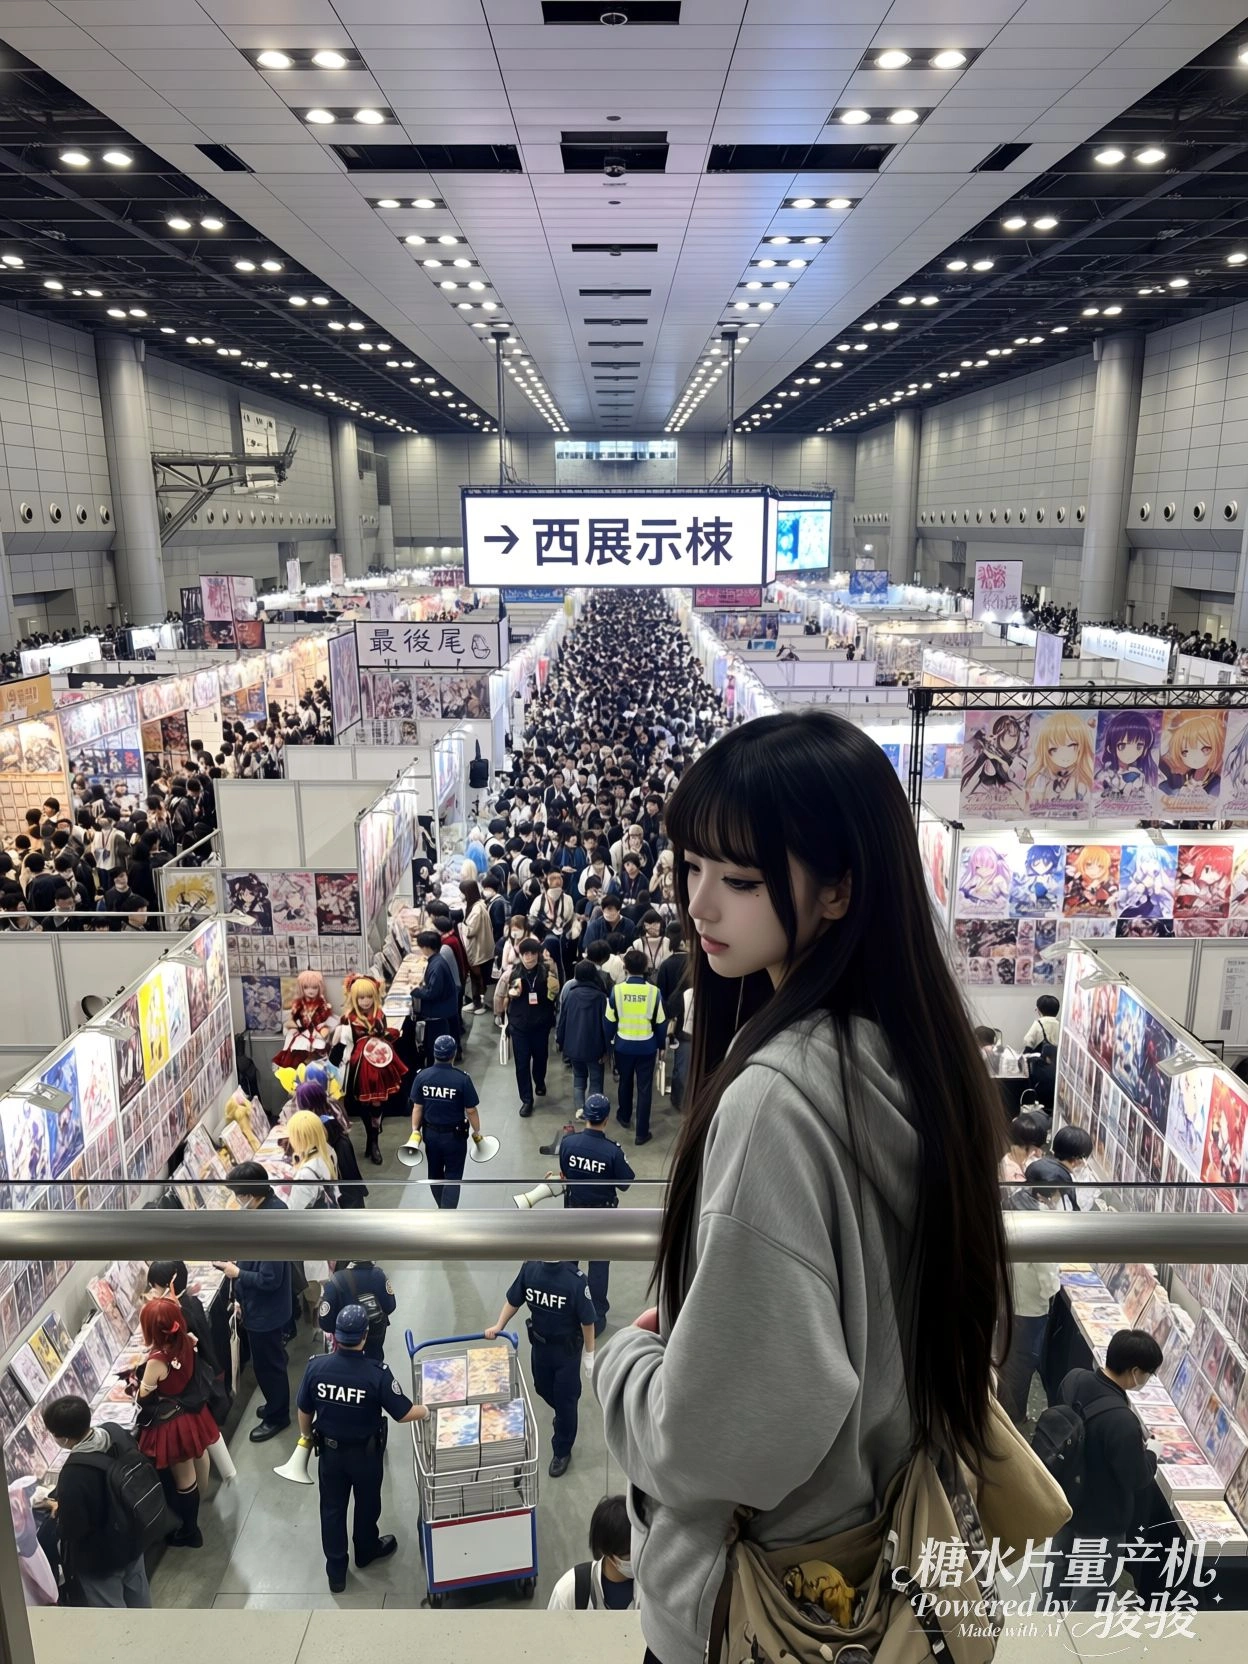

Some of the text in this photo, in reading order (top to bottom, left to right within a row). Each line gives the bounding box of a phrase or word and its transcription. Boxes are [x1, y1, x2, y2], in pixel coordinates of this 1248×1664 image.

[369, 628, 465, 656] 最後尾
[422, 1085, 457, 1099] STAFF
[568, 1154, 606, 1174] STAFF
[525, 1287, 567, 1309] STAFF
[317, 1382, 366, 1404] STAFF
